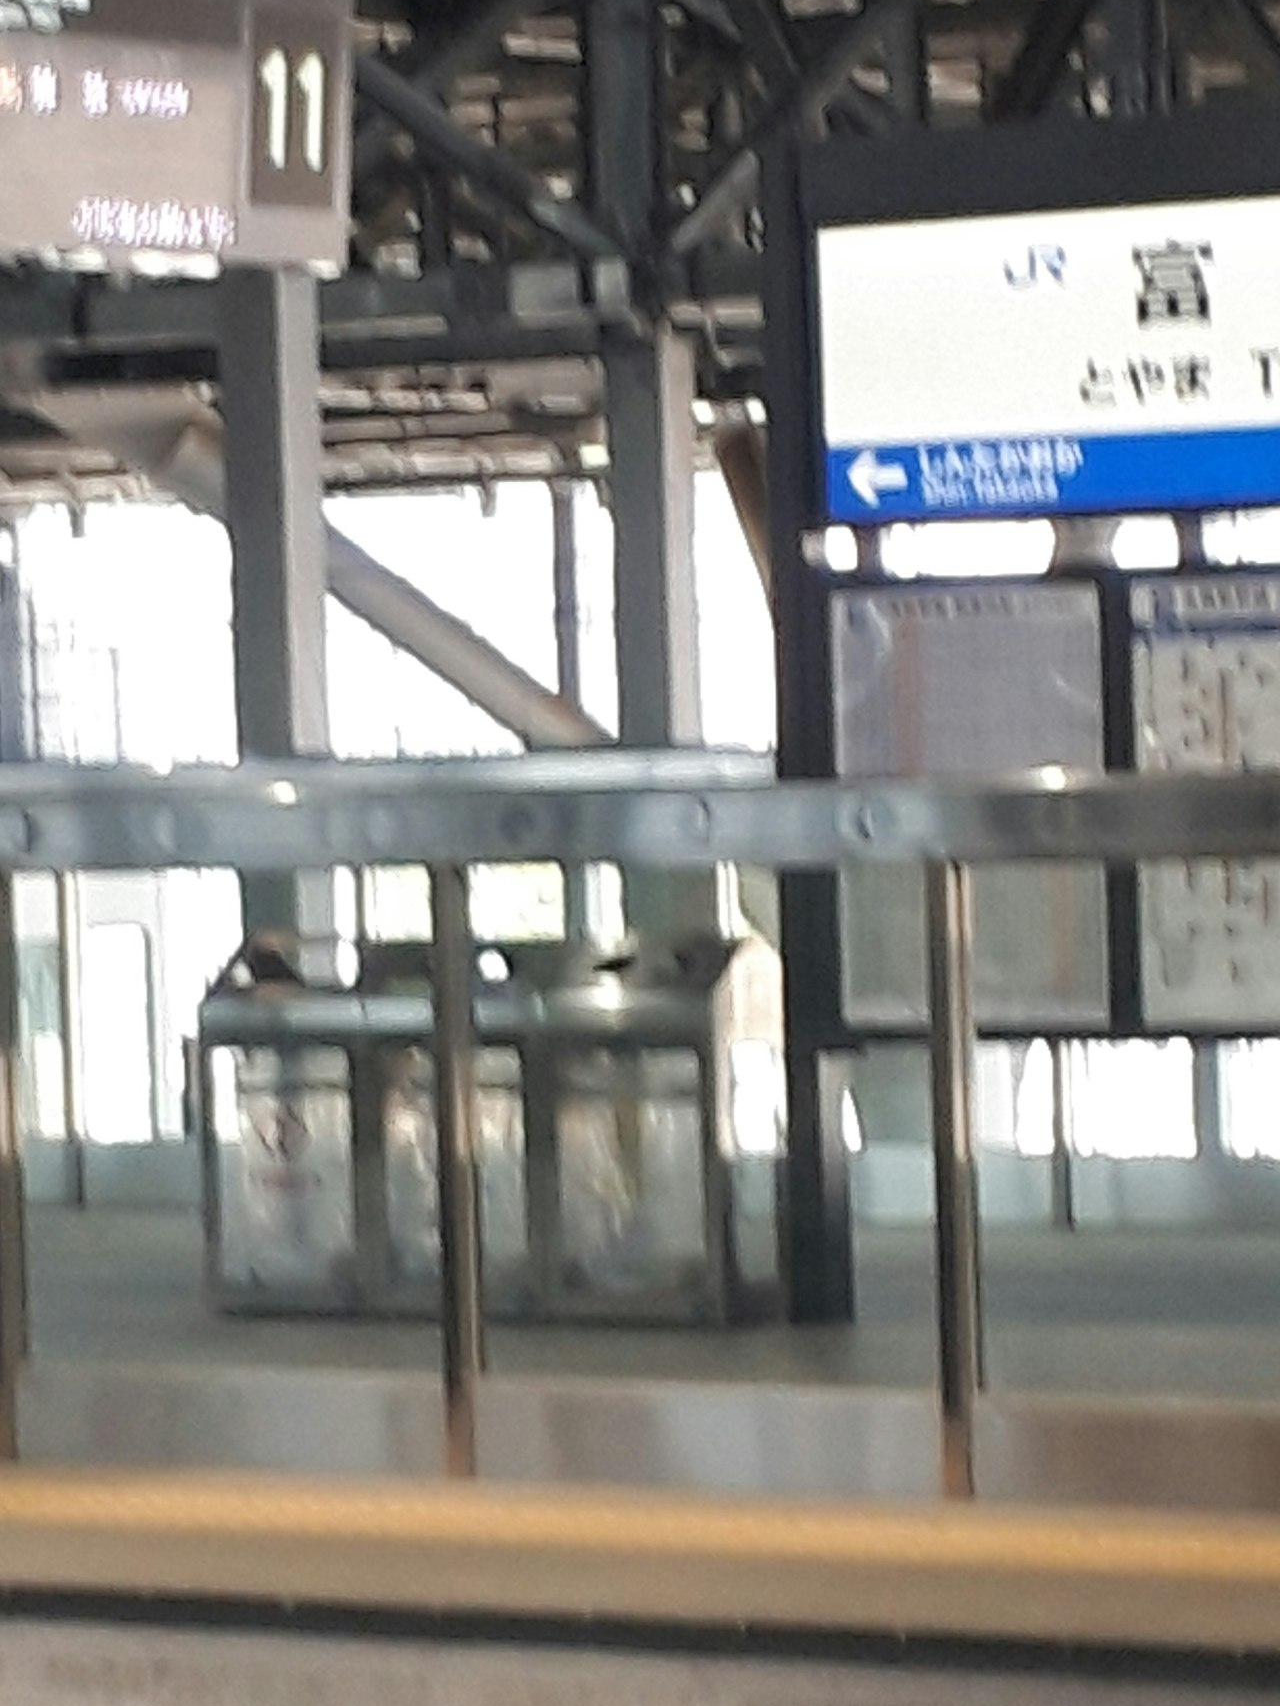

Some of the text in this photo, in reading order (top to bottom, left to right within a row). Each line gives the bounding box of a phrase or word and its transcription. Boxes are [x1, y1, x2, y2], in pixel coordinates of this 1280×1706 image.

[258, 46, 325, 173] 11
[1080, 355, 1211, 407] とやま
